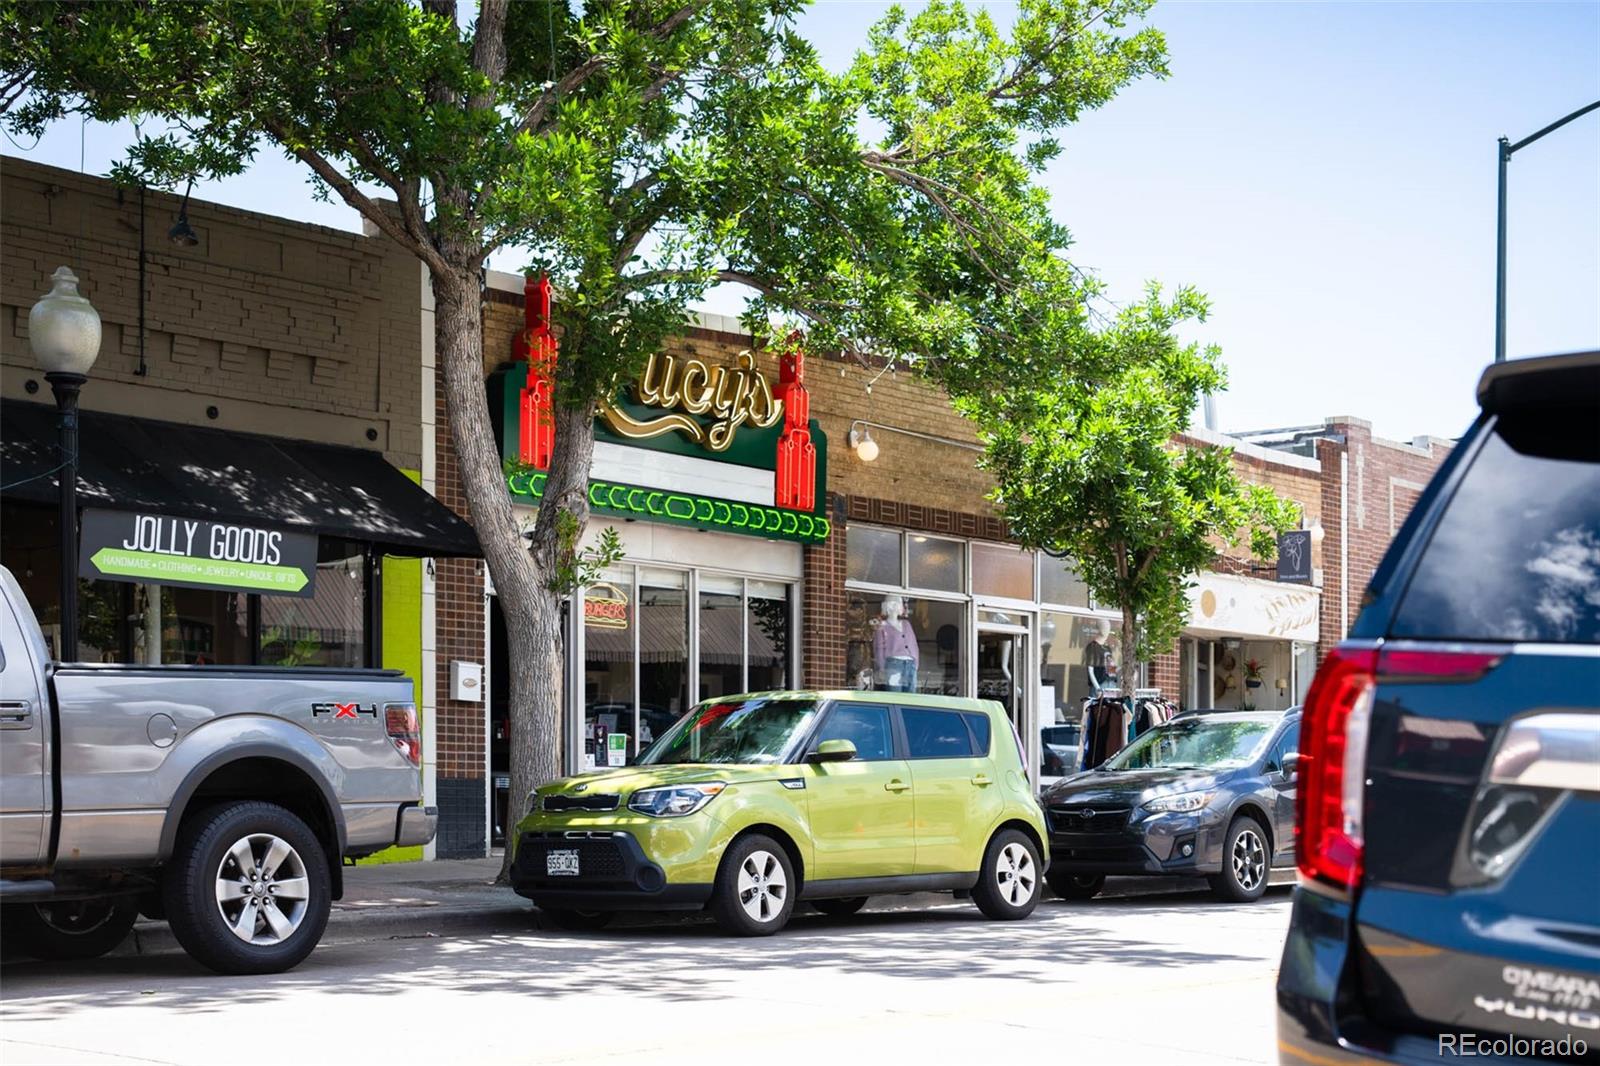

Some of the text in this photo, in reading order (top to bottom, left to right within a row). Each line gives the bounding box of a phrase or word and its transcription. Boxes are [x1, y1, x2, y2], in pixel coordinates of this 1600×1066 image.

[592, 350, 785, 452] ucy's
[123, 515, 282, 566] JOLLY GOODS
[102, 555, 297, 584] HANDMADE CLOTHING JEWELRY UNIQUE GIFTS
[311, 702, 378, 718] FX4
